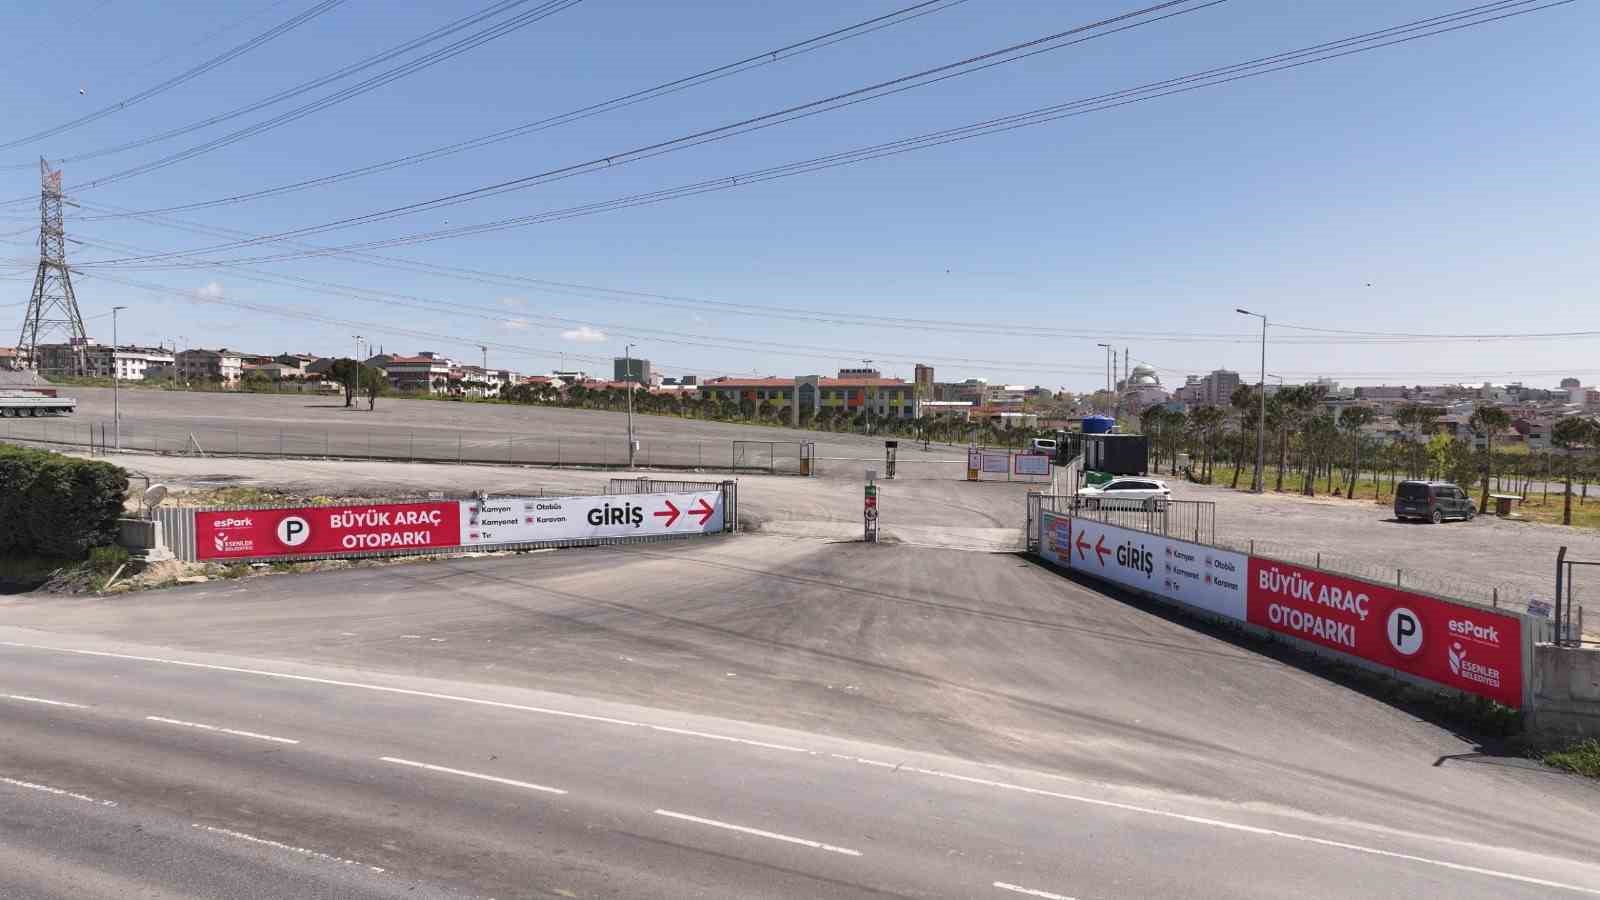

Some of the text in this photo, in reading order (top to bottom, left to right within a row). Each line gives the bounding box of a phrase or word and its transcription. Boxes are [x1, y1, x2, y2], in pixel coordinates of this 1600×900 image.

[213, 517, 253, 528] esPark
[330, 509, 441, 529] BÜYÜK ARAÇ
[587, 502, 643, 528] GİRİŞ
[286, 520, 303, 542] P
[342, 530, 431, 548] OTOPARKI
[1116, 541, 1153, 579] GİRİŞ
[1259, 567, 1369, 621] BÜYÜK ARAÇ
[1268, 602, 1356, 648] OTOPARKI
[1397, 612, 1416, 648] P
[1448, 617, 1500, 643] esPark
[1461, 659, 1500, 679] ESENLER
